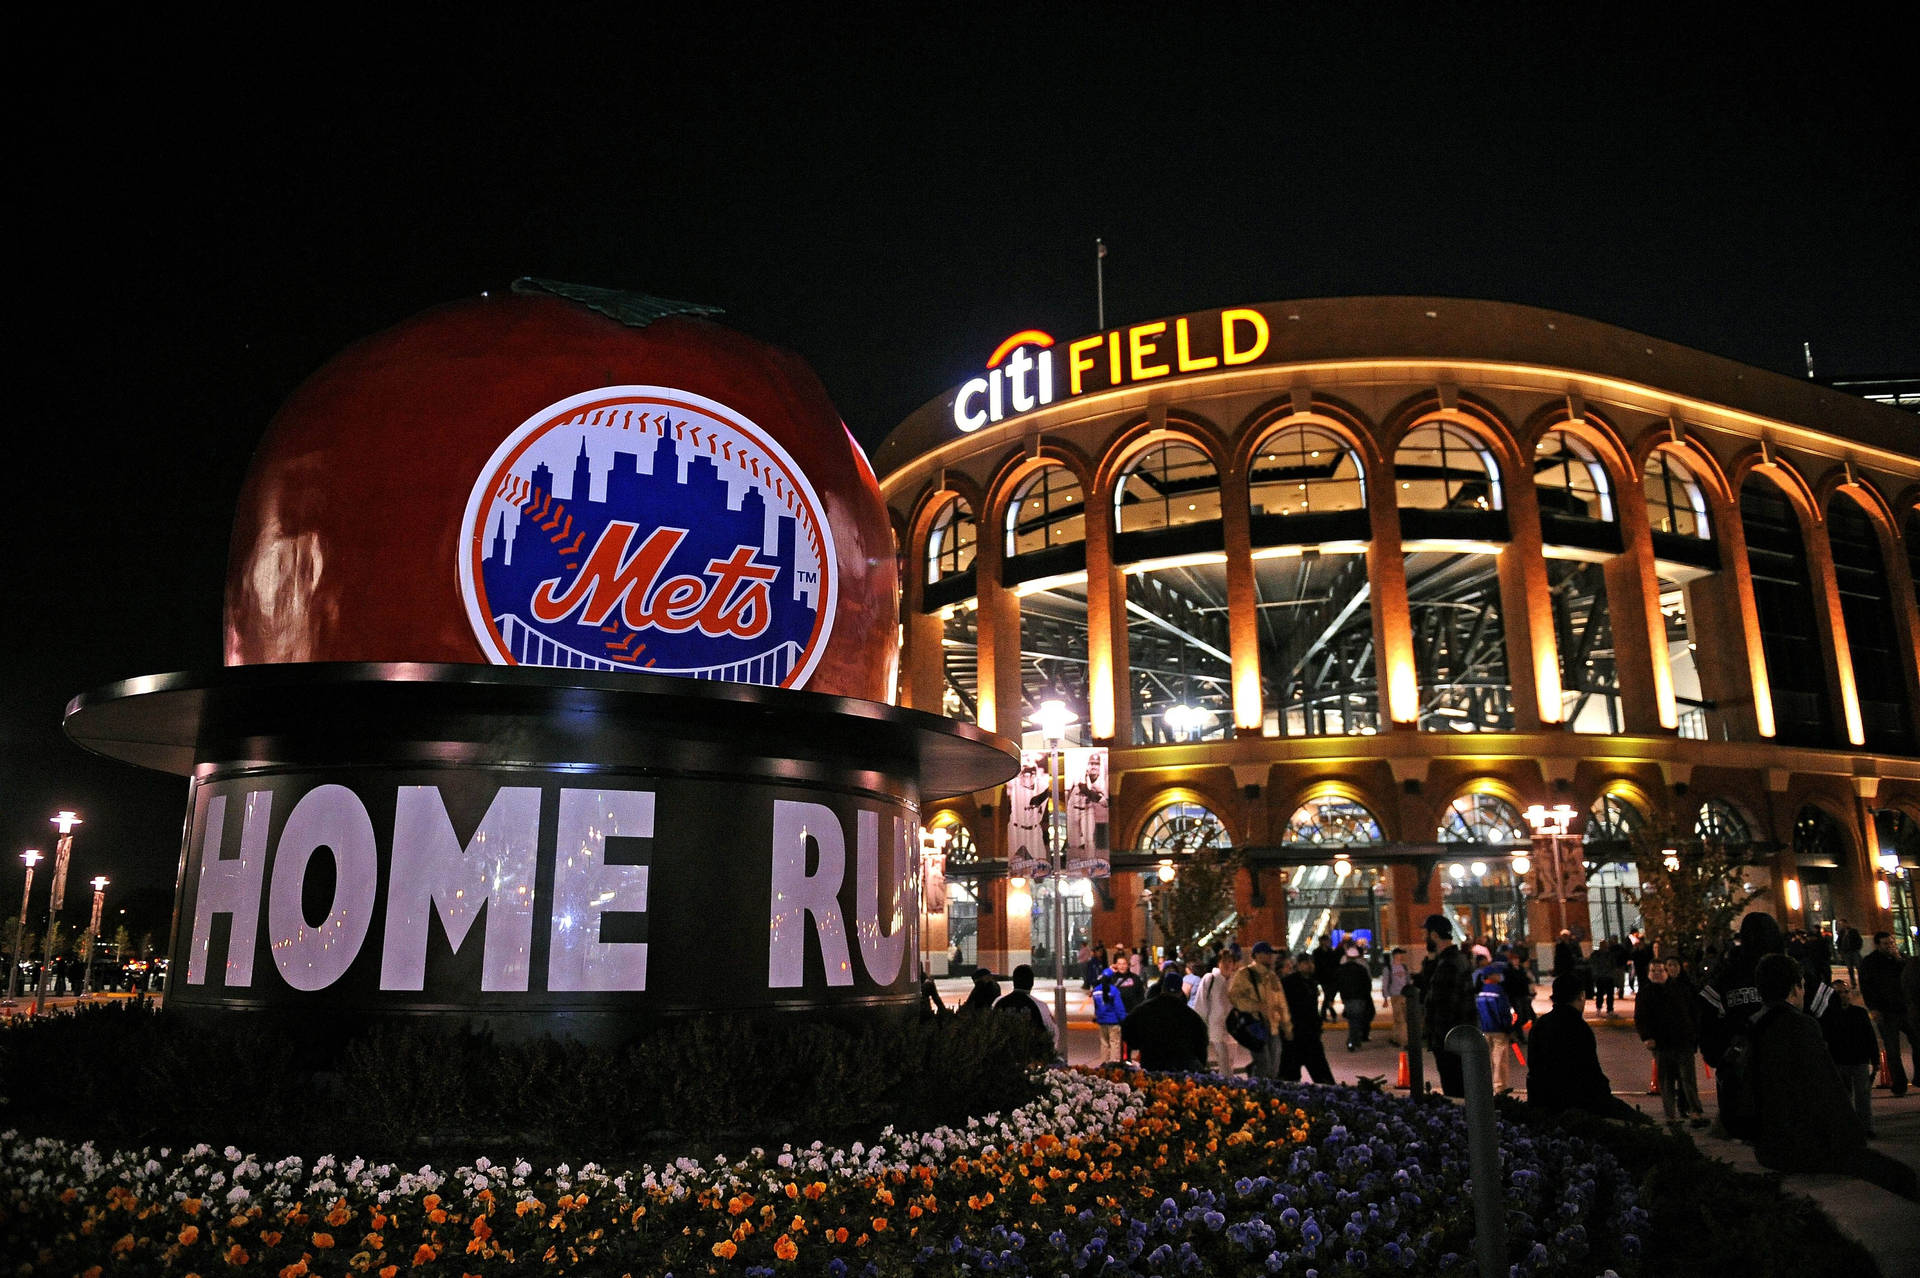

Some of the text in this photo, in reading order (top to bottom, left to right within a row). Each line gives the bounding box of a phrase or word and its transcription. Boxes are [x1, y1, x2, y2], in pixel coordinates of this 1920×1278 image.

[953, 308, 1270, 433] citi FIELD
[530, 519, 781, 639] Mets
[796, 571, 817, 584] TM
[187, 783, 918, 992] HOME RU
